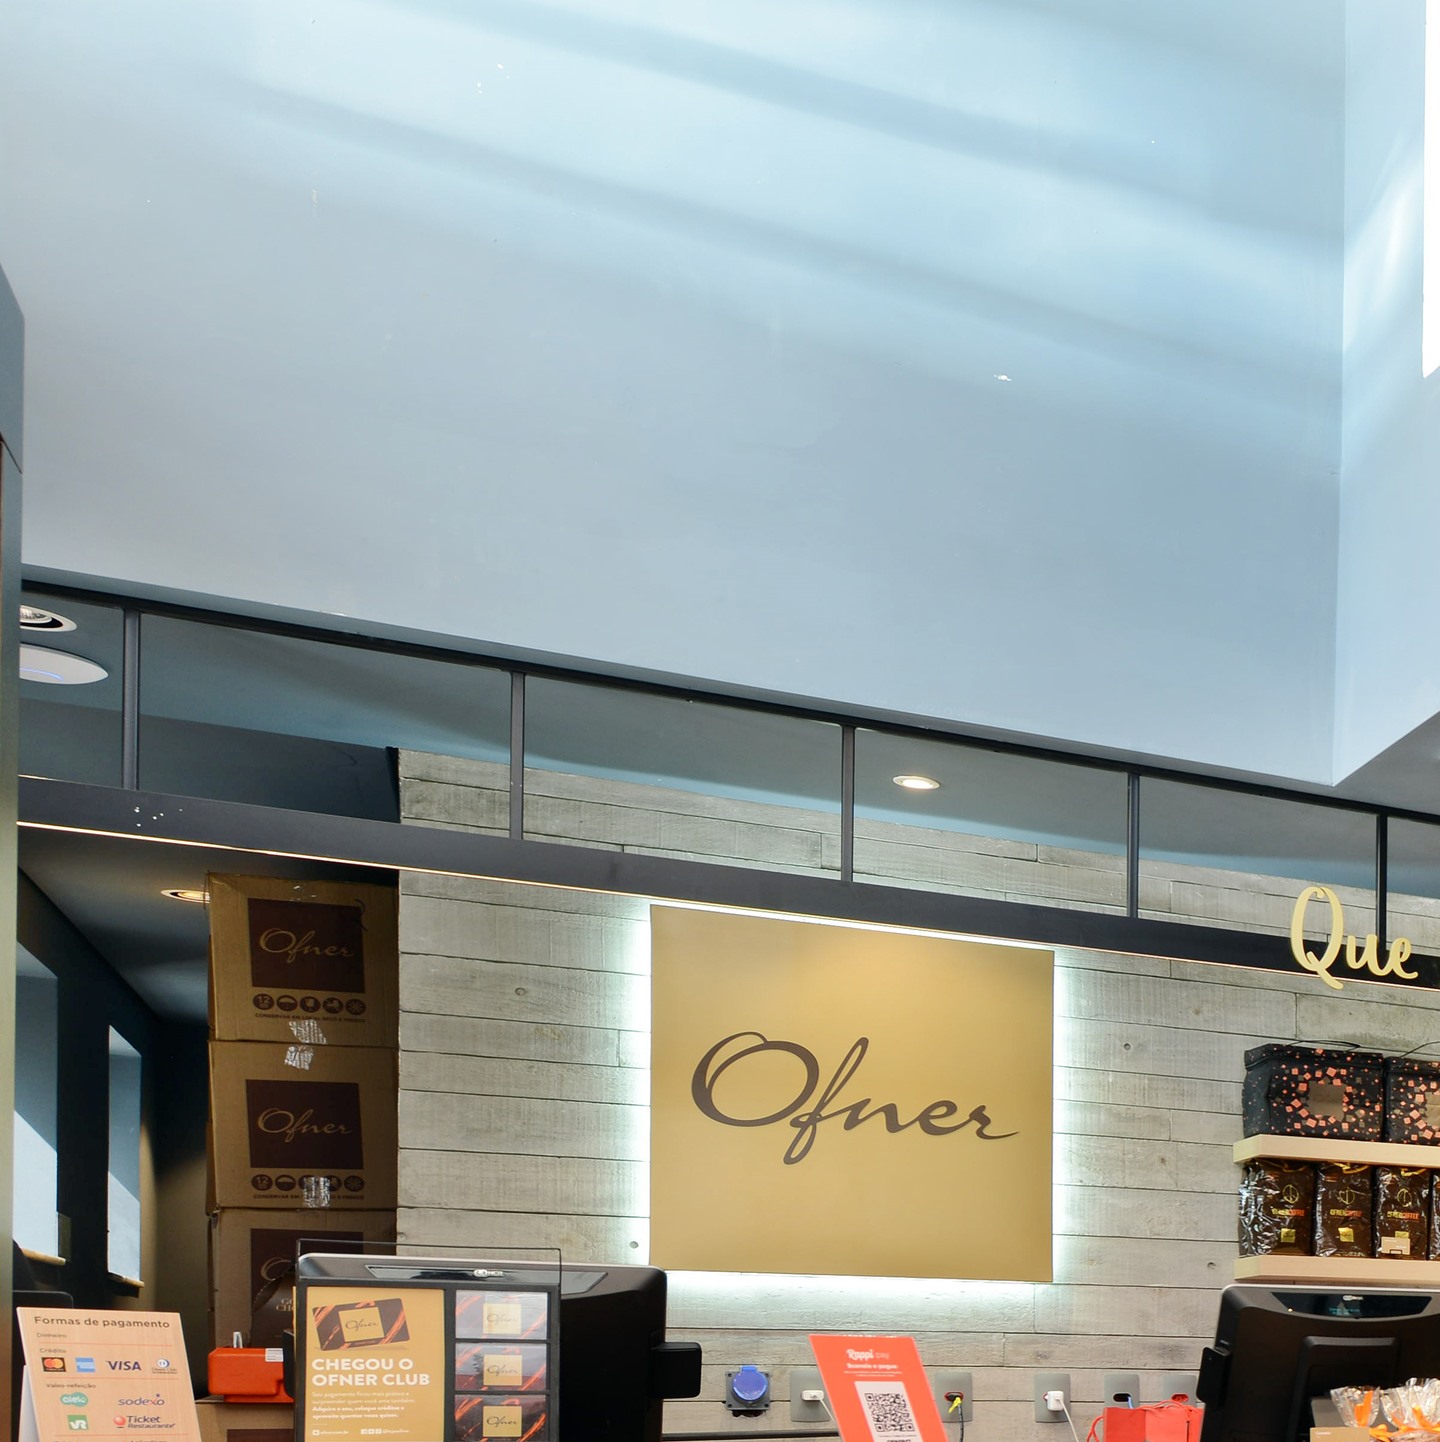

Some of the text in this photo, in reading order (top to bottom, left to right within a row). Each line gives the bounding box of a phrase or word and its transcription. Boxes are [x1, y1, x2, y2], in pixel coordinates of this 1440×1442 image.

[1290, 886, 1419, 990] Que
[259, 928, 355, 964] Ofner
[690, 1030, 1019, 1166] Ofner
[257, 1107, 352, 1143] Ofner
[34, 1316, 171, 1329] Formas de pagamento
[345, 1319, 379, 1331] Ofner
[846, 1348, 875, 1361] Rappi
[106, 1360, 142, 1371] VISA
[311, 1358, 414, 1371] CHEGOU O
[486, 1364, 518, 1376] Ofner
[311, 1373, 431, 1387] OFNER CLUB
[118, 1395, 165, 1406] sodexo
[127, 1415, 161, 1423] Ticket
[486, 1415, 518, 1426] Ofner
